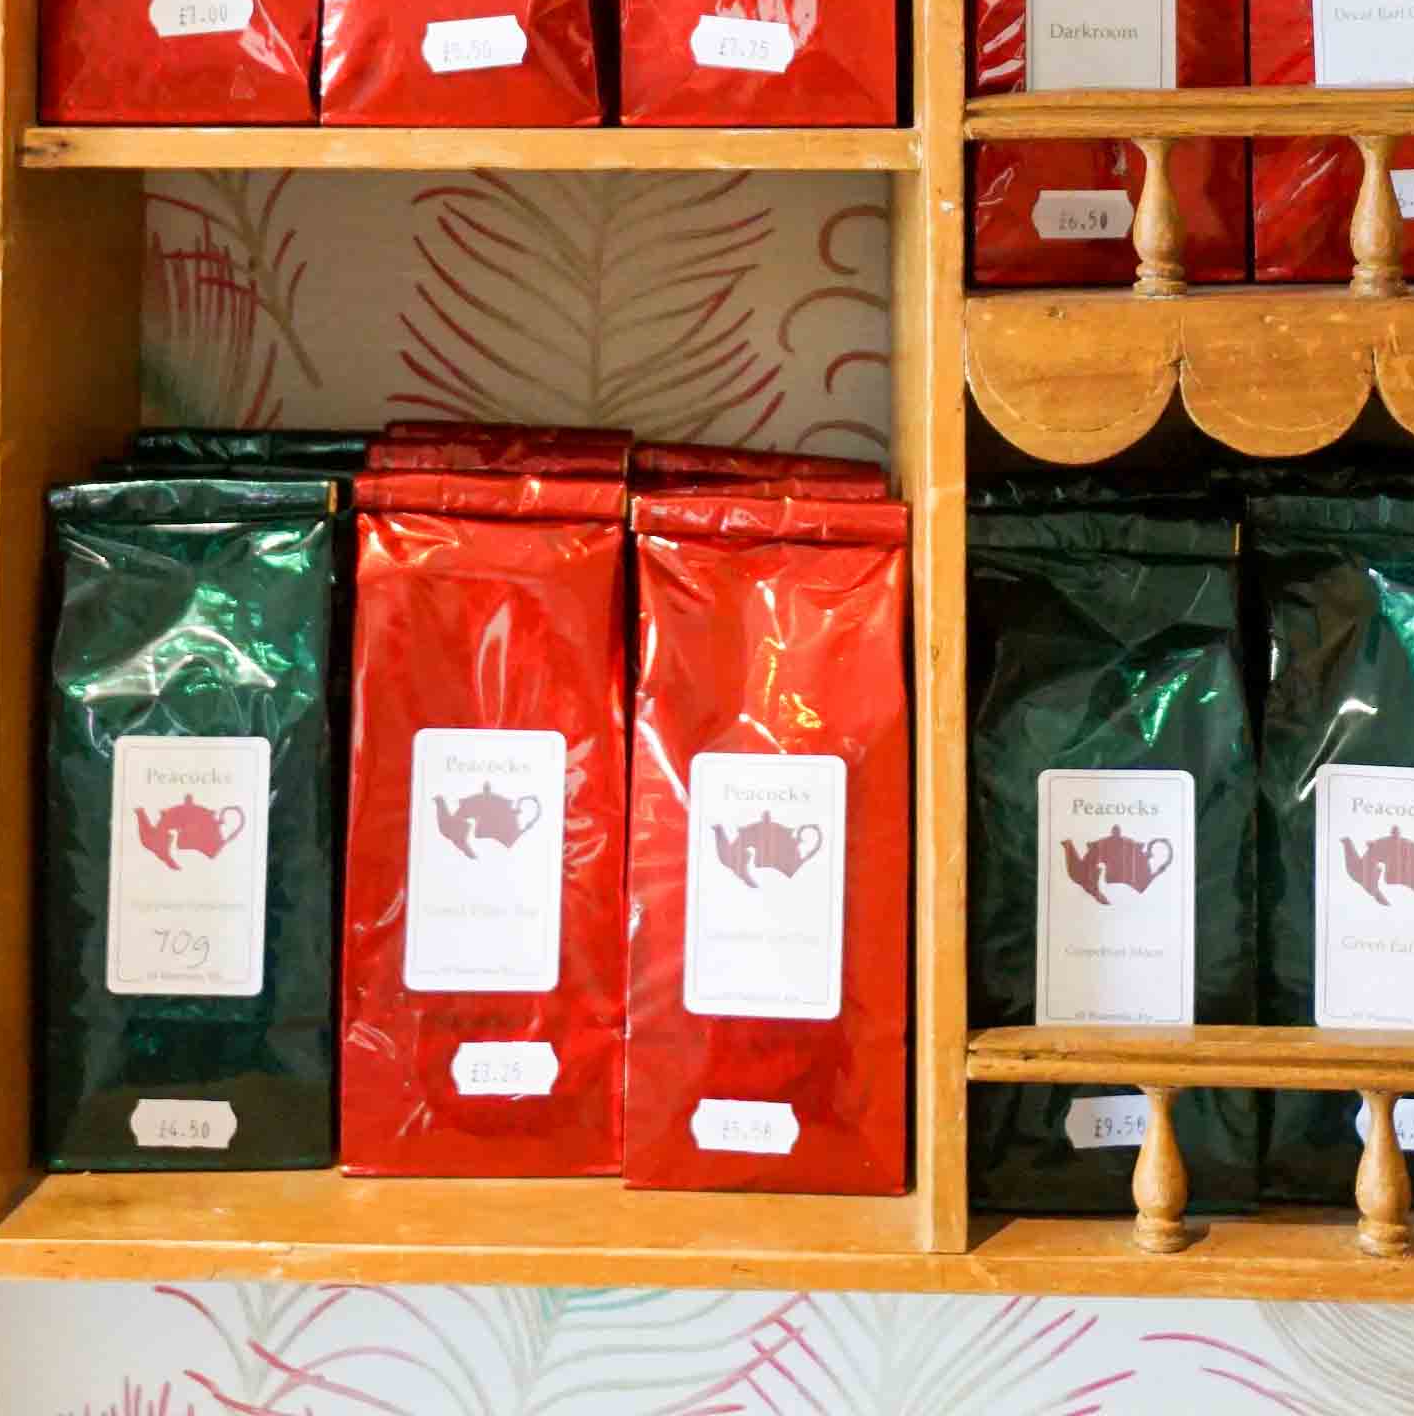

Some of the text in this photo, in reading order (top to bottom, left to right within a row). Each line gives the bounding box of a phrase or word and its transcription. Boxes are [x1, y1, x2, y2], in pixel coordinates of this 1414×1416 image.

[1050, 22, 1139, 40] Darkroom
[445, 756, 532, 774] Peacocks
[146, 766, 233, 785] Peacocks
[724, 783, 812, 802] Peacocks
[1071, 798, 1159, 817] Peacocks
[153, 928, 211, 969] 70g
